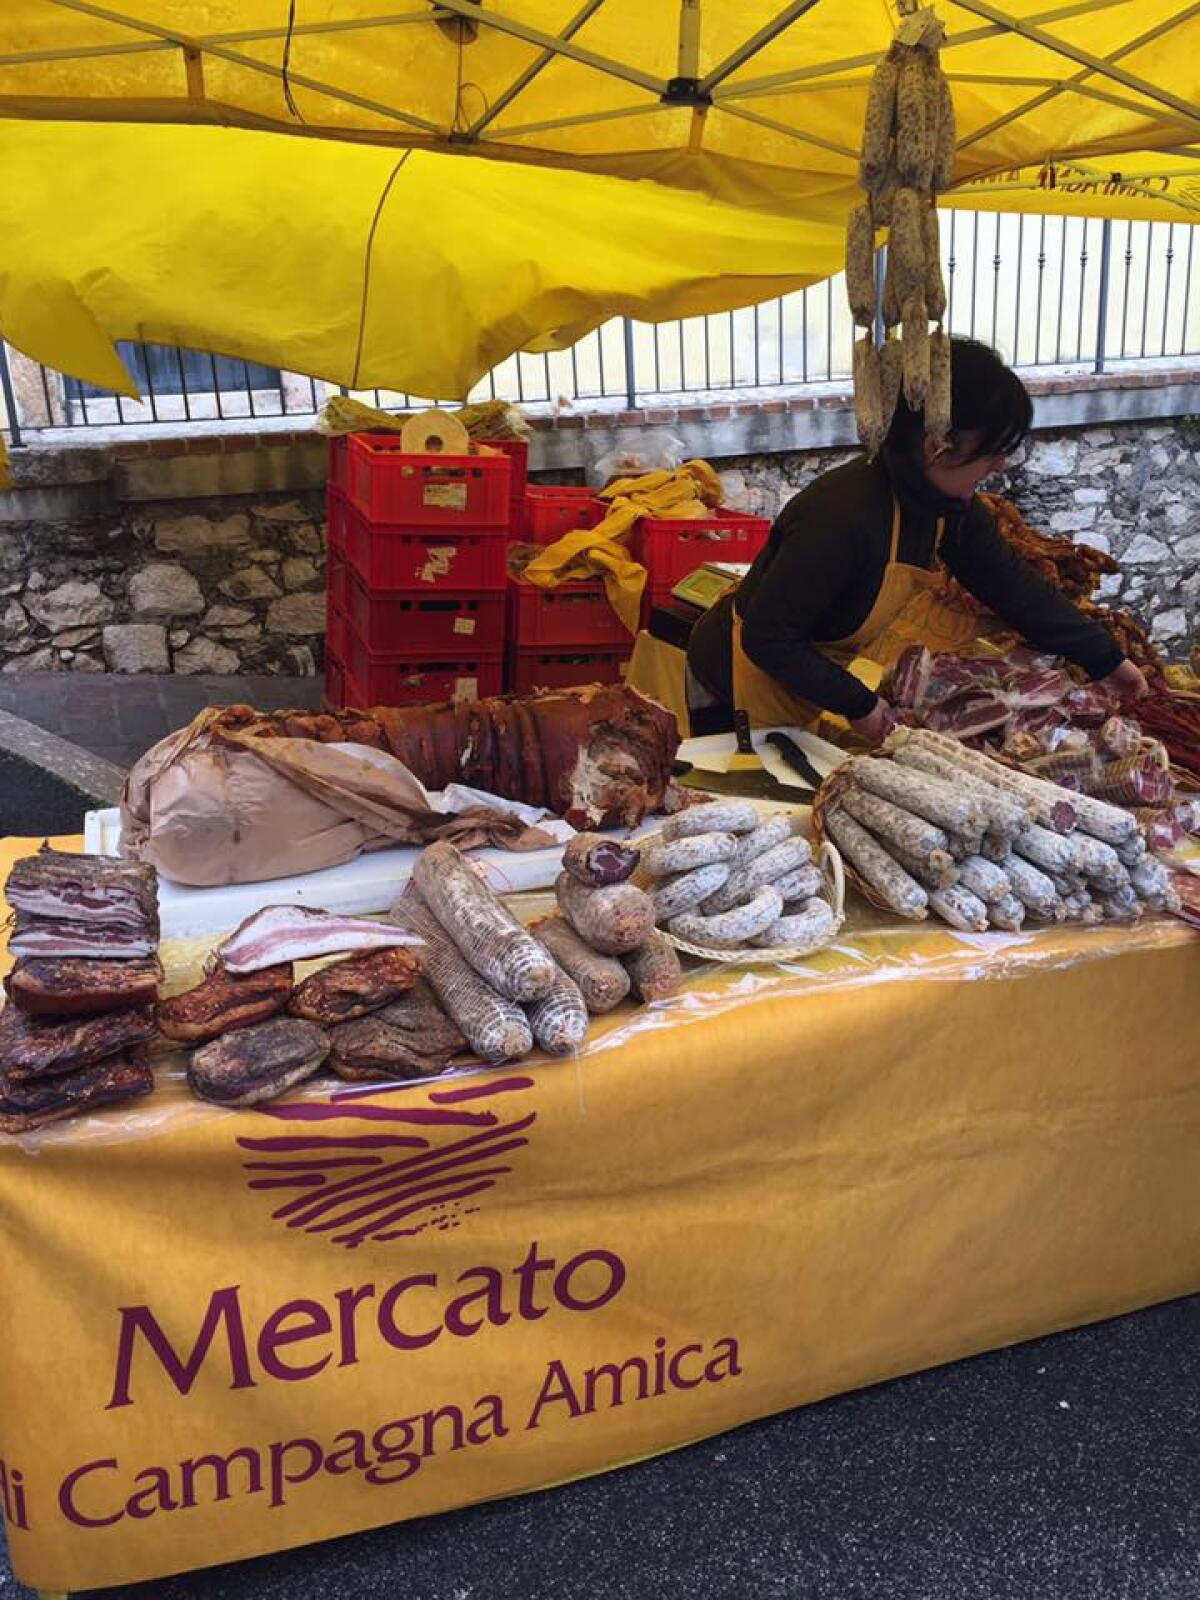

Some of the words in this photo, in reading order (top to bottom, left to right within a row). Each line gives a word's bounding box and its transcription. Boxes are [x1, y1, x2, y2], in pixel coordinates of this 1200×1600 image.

[105, 1241, 626, 1410] Mercato
[57, 1394, 507, 1529] Campagna
[526, 1336, 742, 1429] Amica
